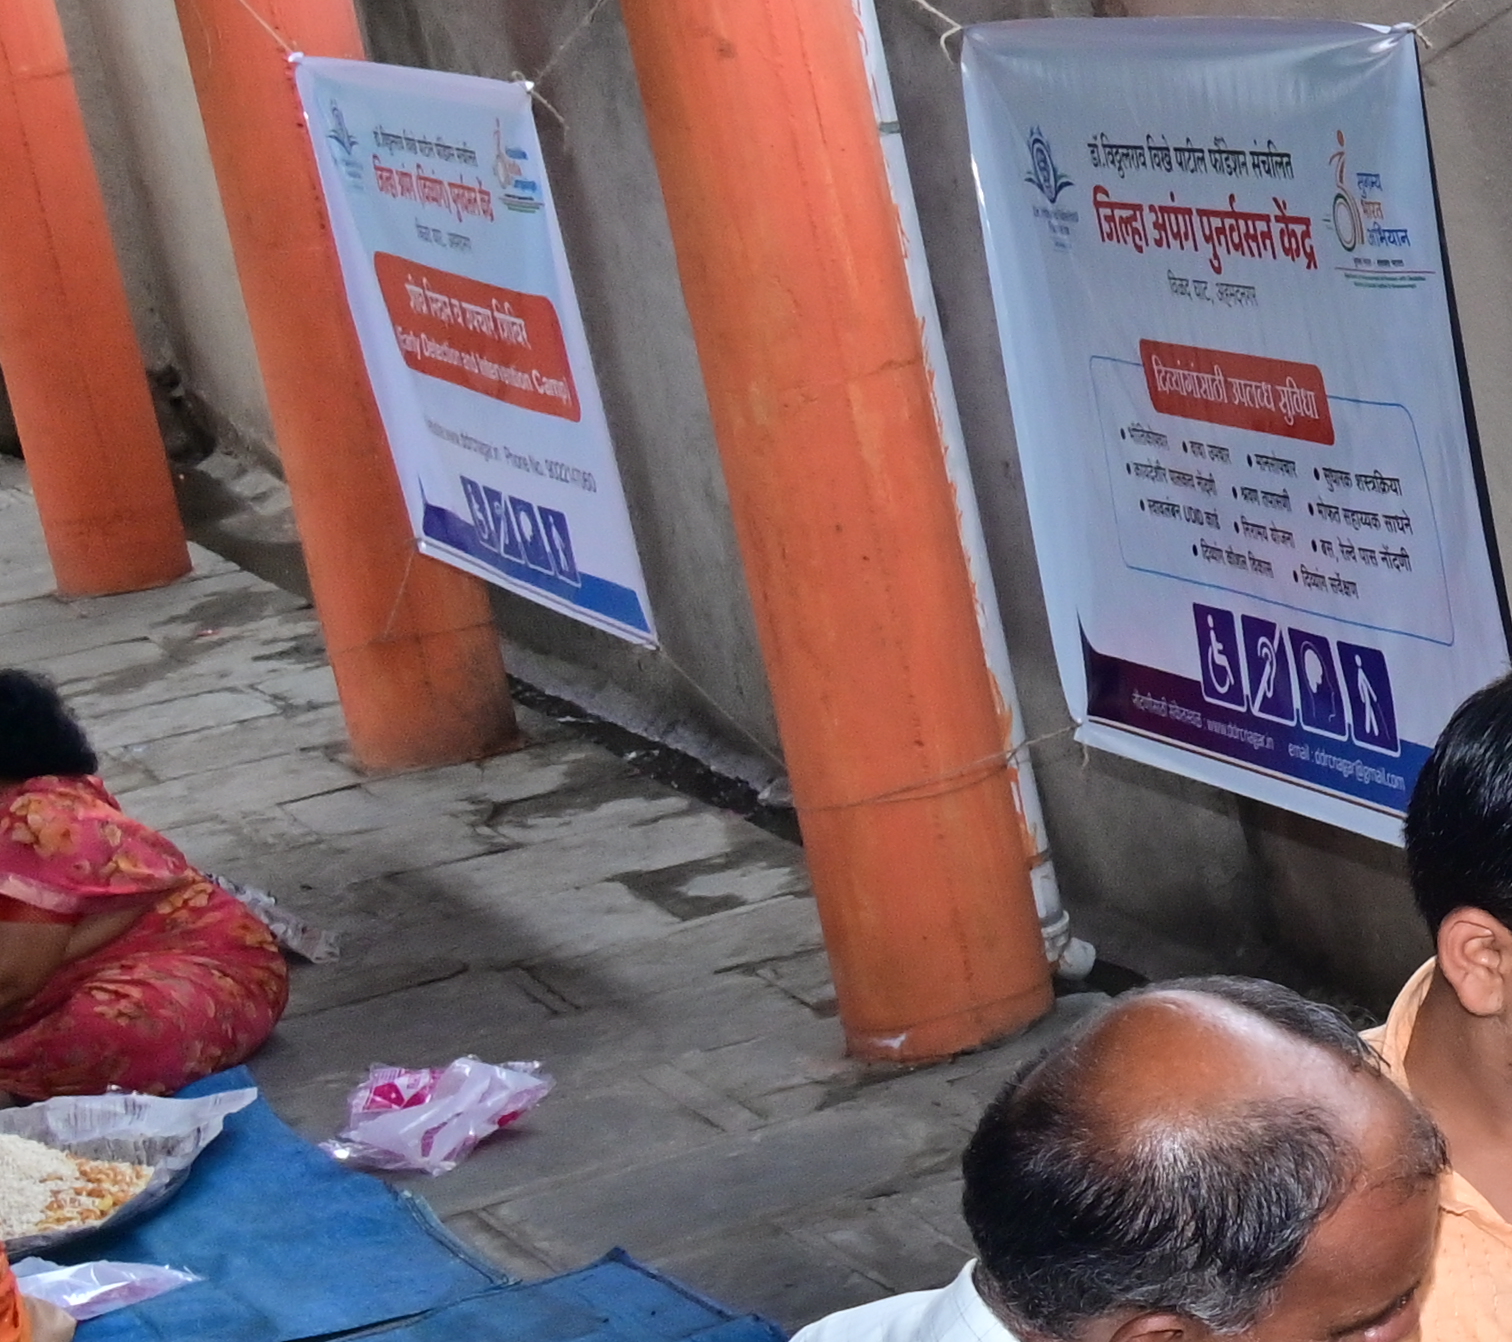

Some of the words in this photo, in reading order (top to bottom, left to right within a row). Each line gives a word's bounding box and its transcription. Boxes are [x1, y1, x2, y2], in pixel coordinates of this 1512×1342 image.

[1173, 138, 1209, 174] पाटील
[1249, 139, 1295, 180] संचलित
[1092, 184, 1149, 254] जिल्हा
[1149, 191, 1199, 252] अपंग
[1195, 193, 1277, 275] पुनर्वसन
[1272, 196, 1319, 271] केंद्र
[1366, 221, 1411, 247] अभियान
[1277, 377, 1320, 426] सुविधा
[1287, 742, 1310, 761] email
[1314, 747, 1406, 791] ddrcnagar@gmail.com
